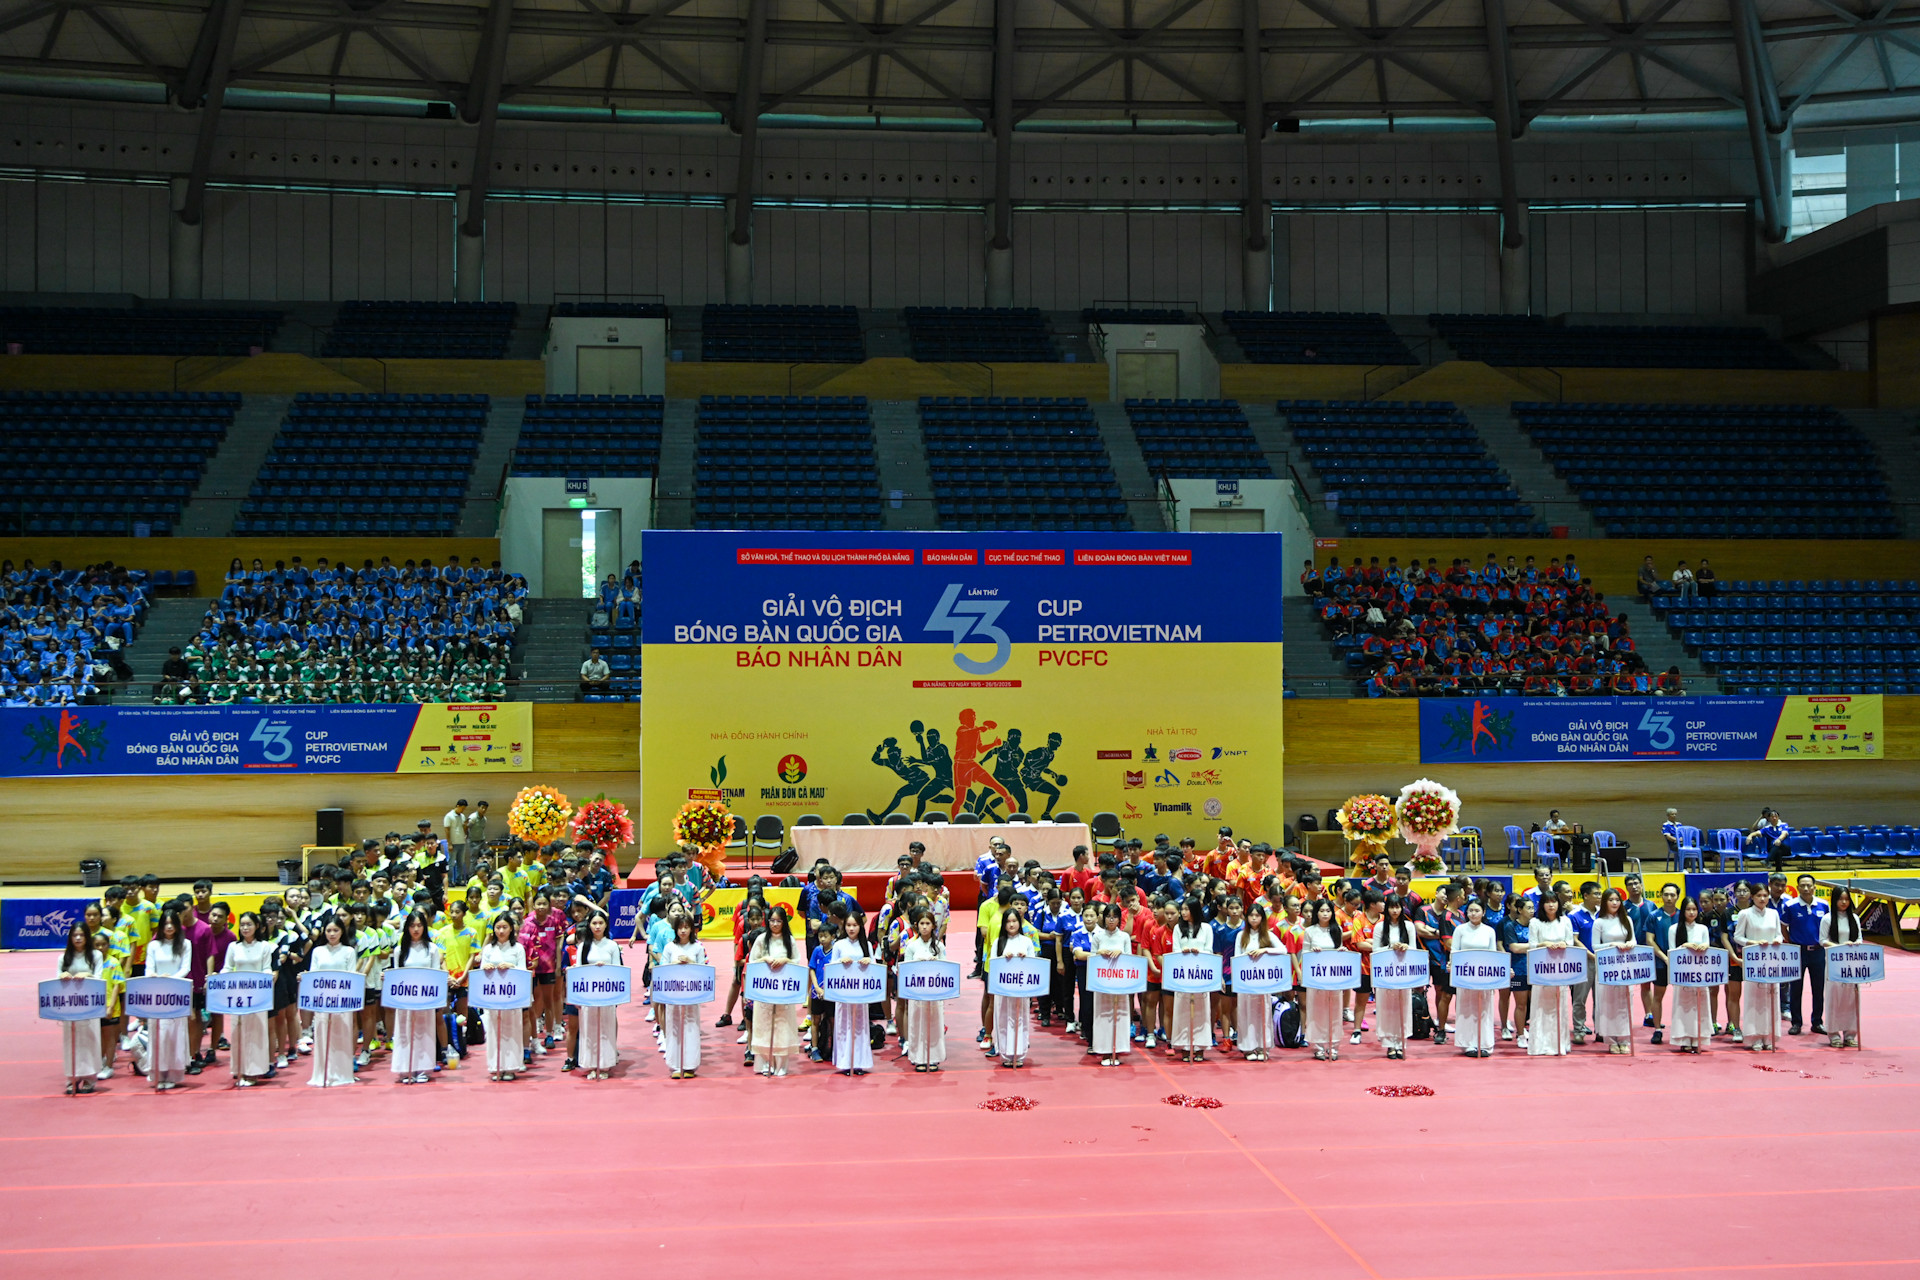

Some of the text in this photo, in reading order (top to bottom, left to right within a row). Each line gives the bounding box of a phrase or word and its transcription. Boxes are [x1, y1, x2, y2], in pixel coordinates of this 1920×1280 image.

[741, 552, 750, 561] SỞ
[751, 553, 764, 561] VĂN
[781, 552, 793, 561] THỂ
[812, 552, 820, 561] VÀ
[831, 554, 846, 562] LỊCH
[846, 553, 867, 561] THÀNH
[869, 552, 882, 561] PHỐ
[882, 553, 891, 561] ĐÀ
[892, 552, 910, 562] NẴNG
[927, 553, 972, 561] BÁO NHÂN DÂN
[988, 554, 1002, 562] CỤC
[1003, 552, 1015, 561] THỂ
[1016, 554, 1029, 562] DỤC
[1030, 552, 1043, 561] THỂ
[1154, 554, 1170, 562] VIỆT
[968, 588, 998, 596] LẦN THỨ
[762, 593, 902, 622] GIẢI VÔ ĐỊCH
[1037, 599, 1083, 617] CUP
[674, 617, 903, 643] BÓNG BÀN QUỐC GIA
[1038, 624, 1202, 642] PETROVIETNAM
[736, 645, 902, 667] BÁO NHÂN DÂN
[1039, 650, 1108, 667] PVCFC
[1147, 728, 1198, 736] NHÀ TÀI TRỢ
[1686, 721, 1706, 729] CUP
[170, 729, 239, 743] GIẢI VÔ ĐỊCH
[305, 731, 328, 740] CUP
[710, 731, 809, 740] NHÀ ĐỒNG HÀNH CHÍNH
[1686, 732, 1757, 741] PETROVIETNAM
[126, 741, 239, 754] BÓNG BÀN QUỐC GIA
[305, 742, 387, 752] PETROVIETNAM
[1686, 743, 1718, 751] PVCFC
[156, 753, 239, 766] BÁO NHÂN DÂN
[305, 755, 341, 764] PVCFC
[761, 785, 825, 799] PHÂN BÓN CÀ MAU
[1154, 802, 1192, 812] Vinamilk
[1866, 904, 1884, 930] SPORT
[1676, 954, 1722, 967] CÂU LẠC BỘ
[1746, 952, 1760, 961] CLB
[1761, 952, 1767, 960] P.
[1781, 951, 1788, 961] Q.
[1790, 952, 1799, 960] 10
[1831, 951, 1880, 961] CLB TRÀNG AN
[1097, 965, 1139, 981] TRỌNG TÀI
[1173, 965, 1213, 980] ĐÀ NẴNG
[1240, 966, 1283, 982] QUÂN ĐỘI
[1310, 963, 1352, 977] TÂY NINH
[1373, 962, 1427, 978] TP. HỒ CHÍ MINH
[1455, 962, 1506, 977] TIỀN GIANG
[1534, 960, 1583, 974] VĨNH LONG
[1746, 963, 1799, 978] TP. HỒ CHÍ MINH
[1841, 964, 1870, 980] HÀ NỘI
[905, 972, 954, 989] LÂM ĐỒNG
[999, 970, 1040, 987] NGHỆ AN
[1603, 967, 1651, 982] PPP CÀ MAU
[1674, 972, 1725, 983] TIMES CITY
[208, 978, 272, 990] CÔNG AN NHÂN DÂN
[313, 977, 351, 990] CÔNG AN
[390, 980, 438, 997] ĐỒNG NAI
[572, 977, 625, 993] HẢI PHÒNG
[653, 977, 714, 991] HẢI DƯƠNG-LONG HẢI
[752, 976, 801, 992] HƯNG YÊN
[827, 974, 882, 990] KHÁNH HÒA
[483, 981, 516, 999] HÀ NỘI
[40, 992, 106, 1010] BÀ RỊA-VŨNG TÀU
[128, 992, 190, 1006] BÌNH DƯƠNG
[227, 996, 253, 1008] T & T
[301, 992, 362, 1009] TP. HỒ CHÍ MINH
